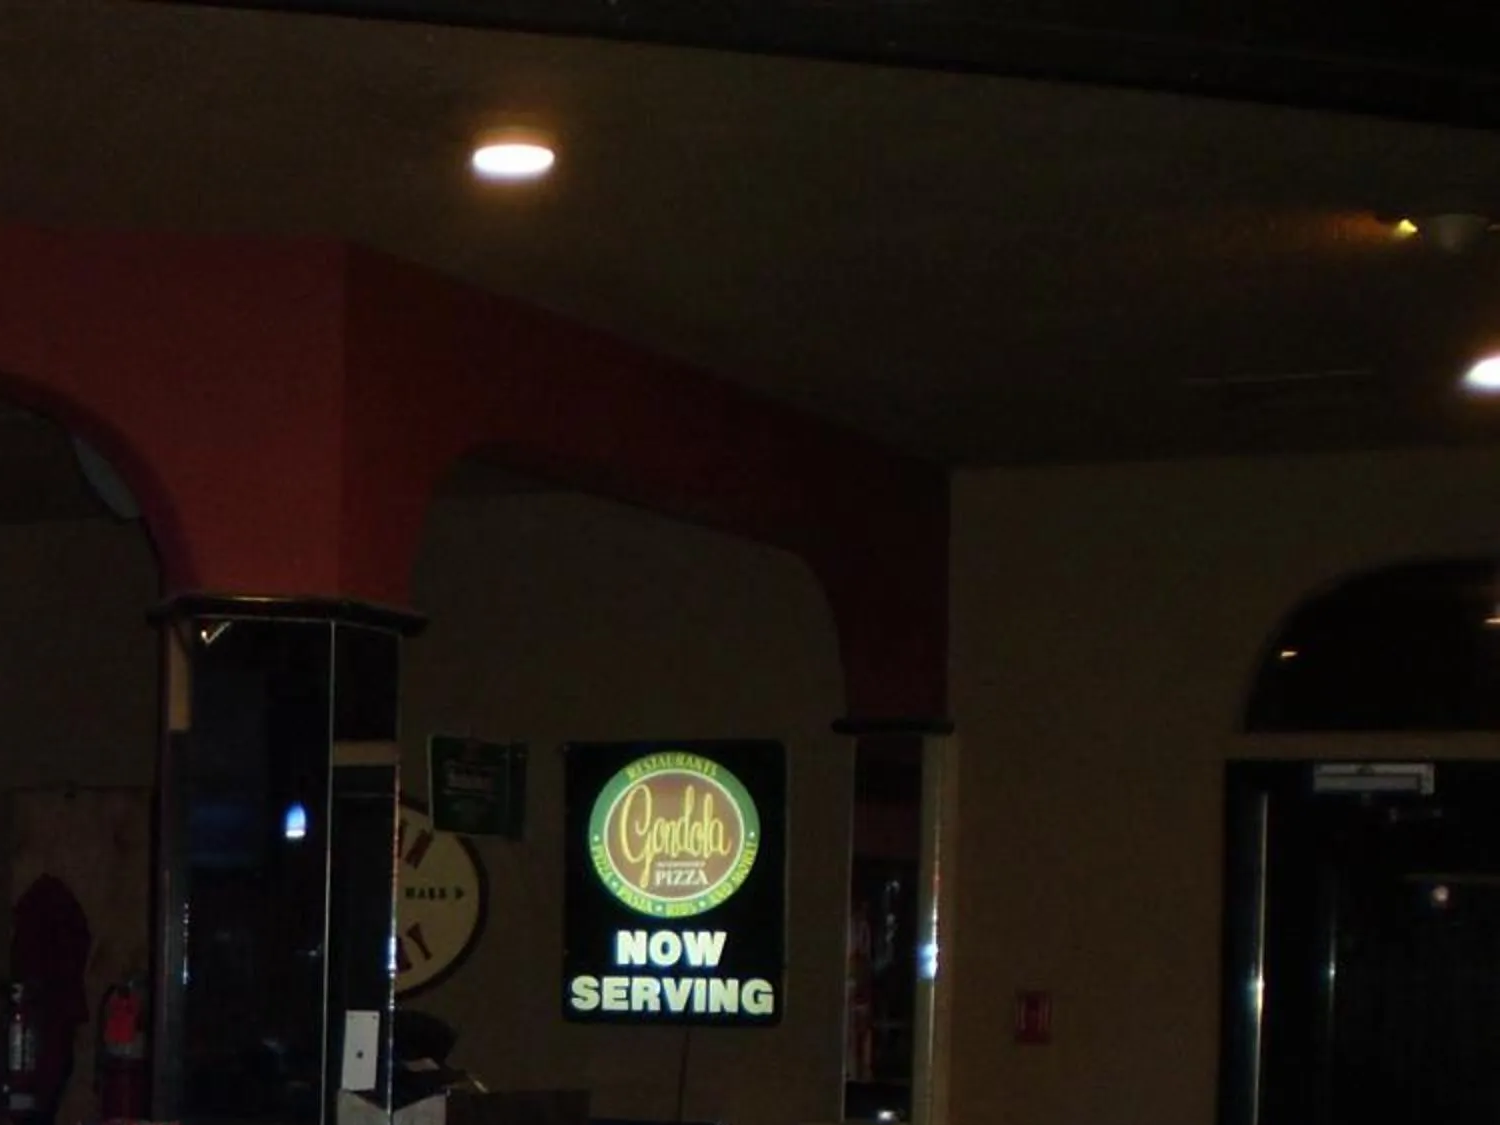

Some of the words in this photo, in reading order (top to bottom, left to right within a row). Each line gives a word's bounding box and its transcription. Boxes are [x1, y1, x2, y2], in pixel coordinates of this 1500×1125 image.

[620, 784, 732, 888] Gondola
[654, 869, 709, 886] PIZZA
[616, 930, 727, 967] NOW
[570, 975, 775, 1015] SERVING
